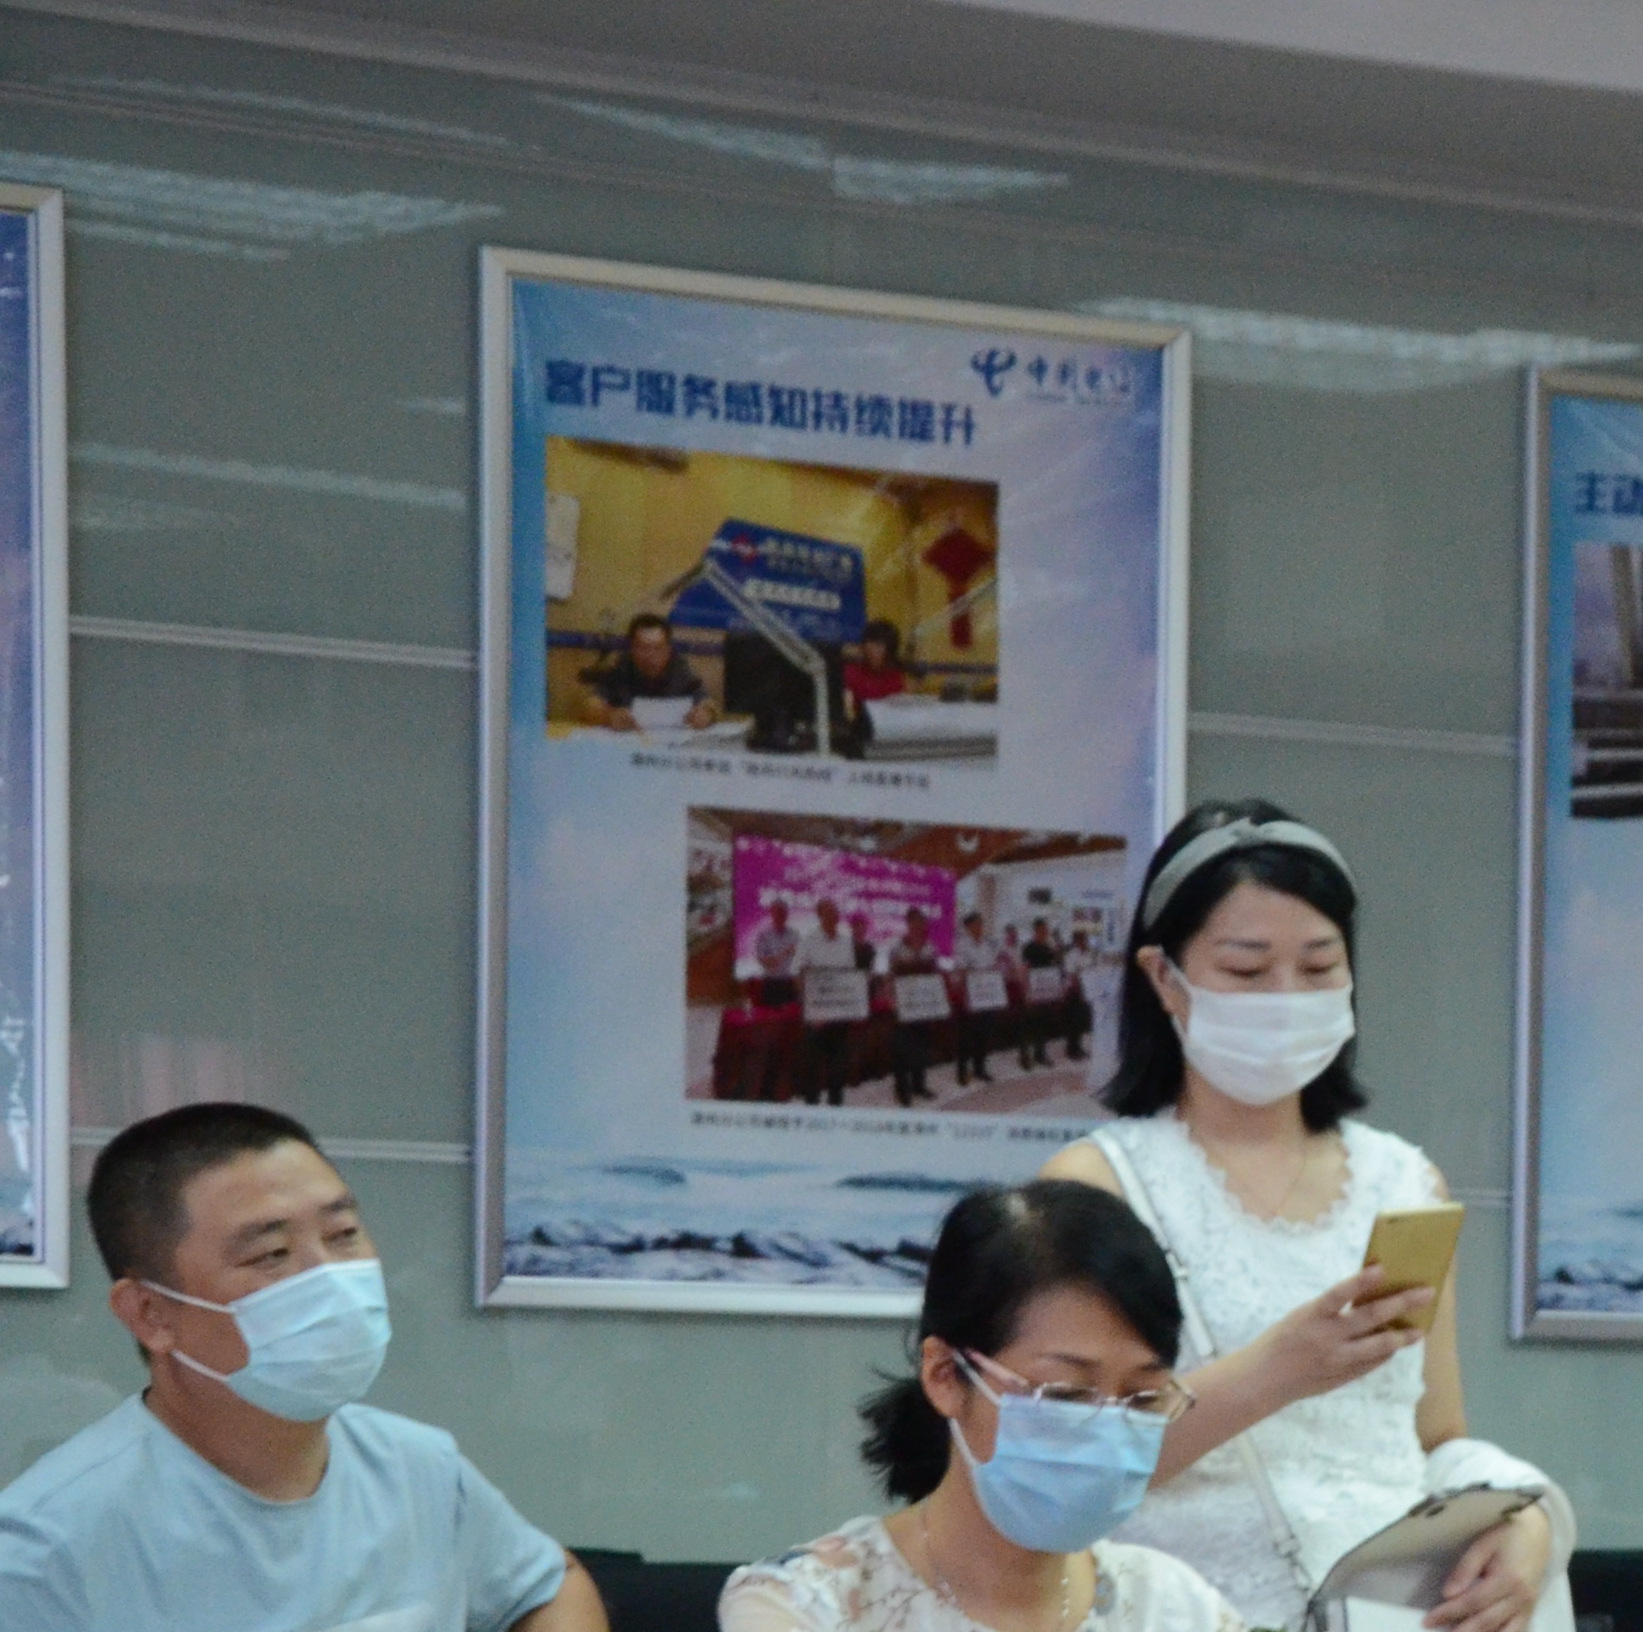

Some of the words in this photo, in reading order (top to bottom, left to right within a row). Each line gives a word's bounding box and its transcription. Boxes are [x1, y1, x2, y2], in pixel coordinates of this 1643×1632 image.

[545, 359, 975, 445] 客户服务感知持续提升
